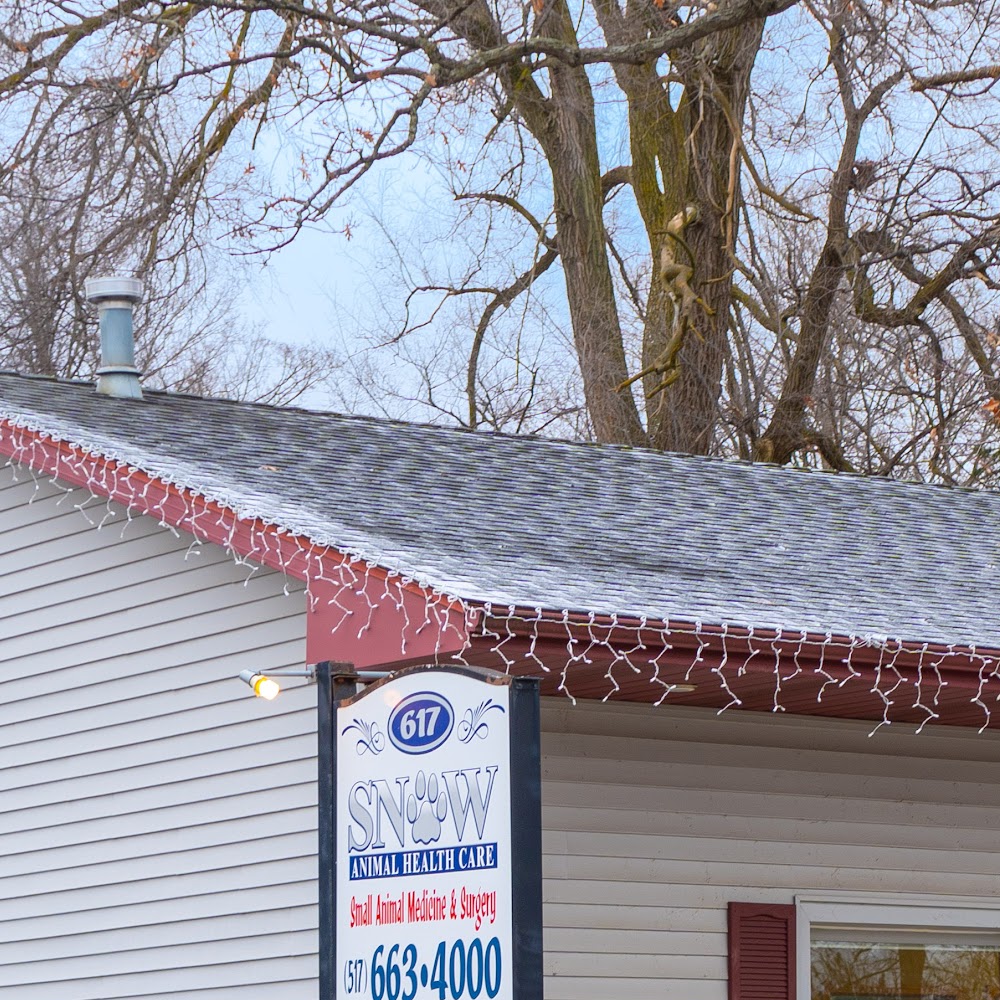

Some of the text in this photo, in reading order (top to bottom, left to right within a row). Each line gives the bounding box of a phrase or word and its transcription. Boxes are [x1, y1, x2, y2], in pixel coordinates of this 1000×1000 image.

[400, 706, 442, 740] 617
[351, 844, 494, 879] ANIMAL HEALTH CARE
[350, 886, 496, 931] Small Animal Medicine & Surgery
[343, 958, 368, 995] (517)
